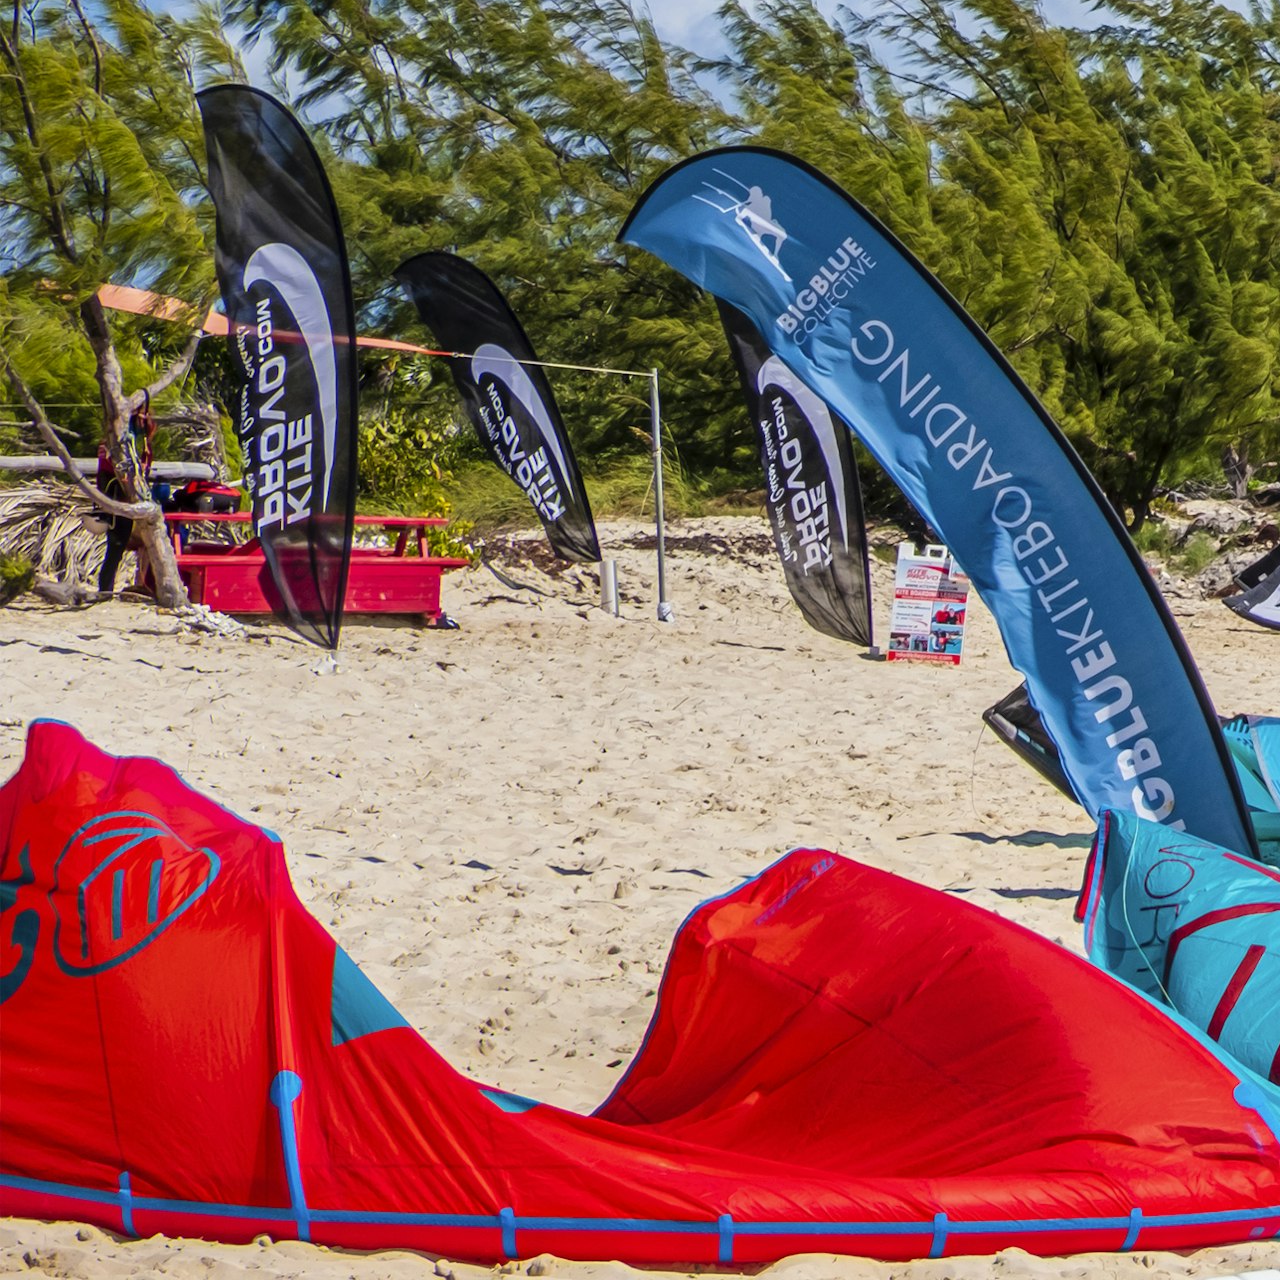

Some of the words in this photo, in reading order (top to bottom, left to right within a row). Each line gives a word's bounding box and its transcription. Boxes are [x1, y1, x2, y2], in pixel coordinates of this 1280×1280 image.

[776, 236, 864, 336] BIGBLUE
[792, 250, 877, 348] COLLECTIVE
[850, 317, 1187, 832] GBLUEKITEBOARDING
